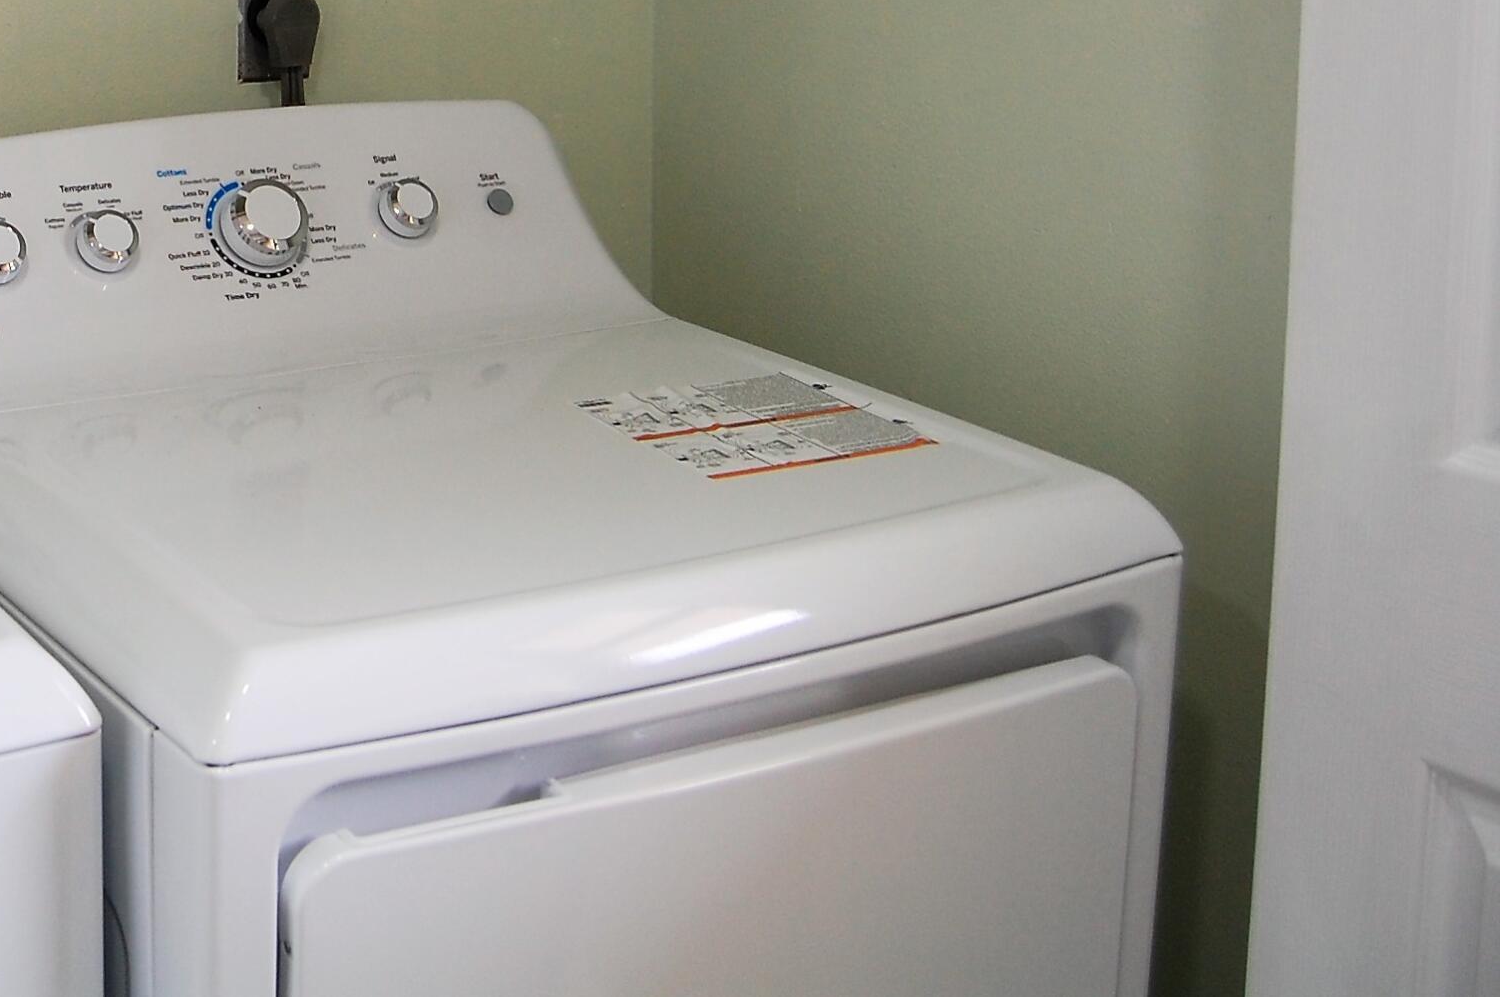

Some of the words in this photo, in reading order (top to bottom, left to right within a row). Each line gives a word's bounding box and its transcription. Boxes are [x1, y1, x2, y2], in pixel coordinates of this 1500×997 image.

[372, 154, 397, 164] Signal
[156, 169, 187, 177] Cottons
[479, 173, 499, 181] Start
[59, 183, 112, 193] Temperature
[225, 293, 244, 301] Time
